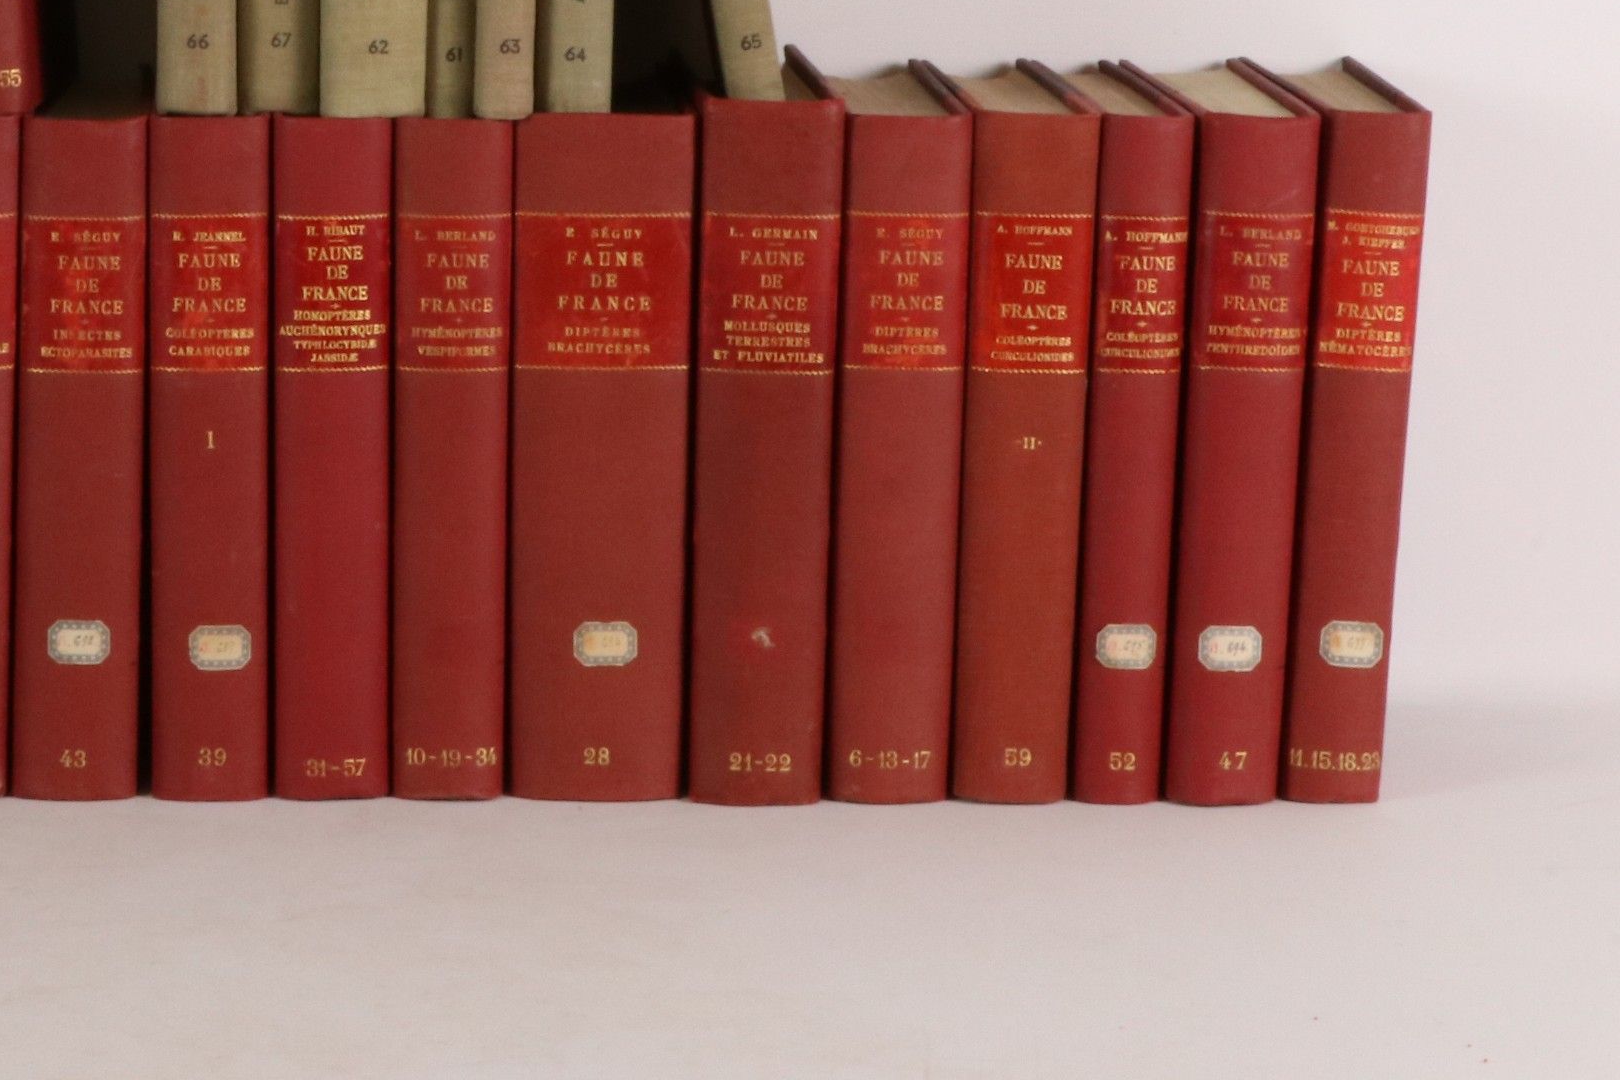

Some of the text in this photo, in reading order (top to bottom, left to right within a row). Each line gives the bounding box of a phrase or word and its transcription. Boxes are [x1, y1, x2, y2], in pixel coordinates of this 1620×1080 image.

[186, 34, 209, 49] 66
[271, 32, 293, 48] 67
[368, 40, 388, 55] 62
[499, 39, 520, 54] 63
[740, 34, 761, 51] 65
[446, 44, 465, 66] 61
[564, 47, 586, 62] 64
[752, 228, 818, 240] GERMAIN
[308, 245, 363, 260] FAUNE
[567, 252, 643, 266] FAUNE
[741, 251, 804, 266] FAUNE
[1234, 252, 1289, 268] FAUNE
[179, 253, 240, 268] FAUNE
[327, 265, 348, 279] DE
[198, 277, 221, 291] DE
[591, 273, 617, 287] DE
[761, 274, 783, 288] DE
[1250, 275, 1271, 290] DE
[303, 285, 368, 300] FRANCE
[173, 297, 246, 313] FRANCE
[559, 296, 650, 311] FRANCE
[732, 294, 807, 311] FRANCE
[1225, 296, 1289, 314] FRANCE
[724, 321, 810, 334] MOLLUSQUES
[713, 350, 824, 364] ET FLUVIATILES
[60, 750, 86, 767] 43
[198, 748, 226, 766] 39
[407, 747, 497, 767] 10-19-34
[584, 747, 609, 765] 28
[730, 753, 791, 773] 21-22
[849, 750, 931, 770] 6-13-17
[1005, 748, 1032, 766] 59
[1110, 752, 1136, 771] 52
[1220, 751, 1247, 770] 47
[307, 758, 366, 776] 31-57
